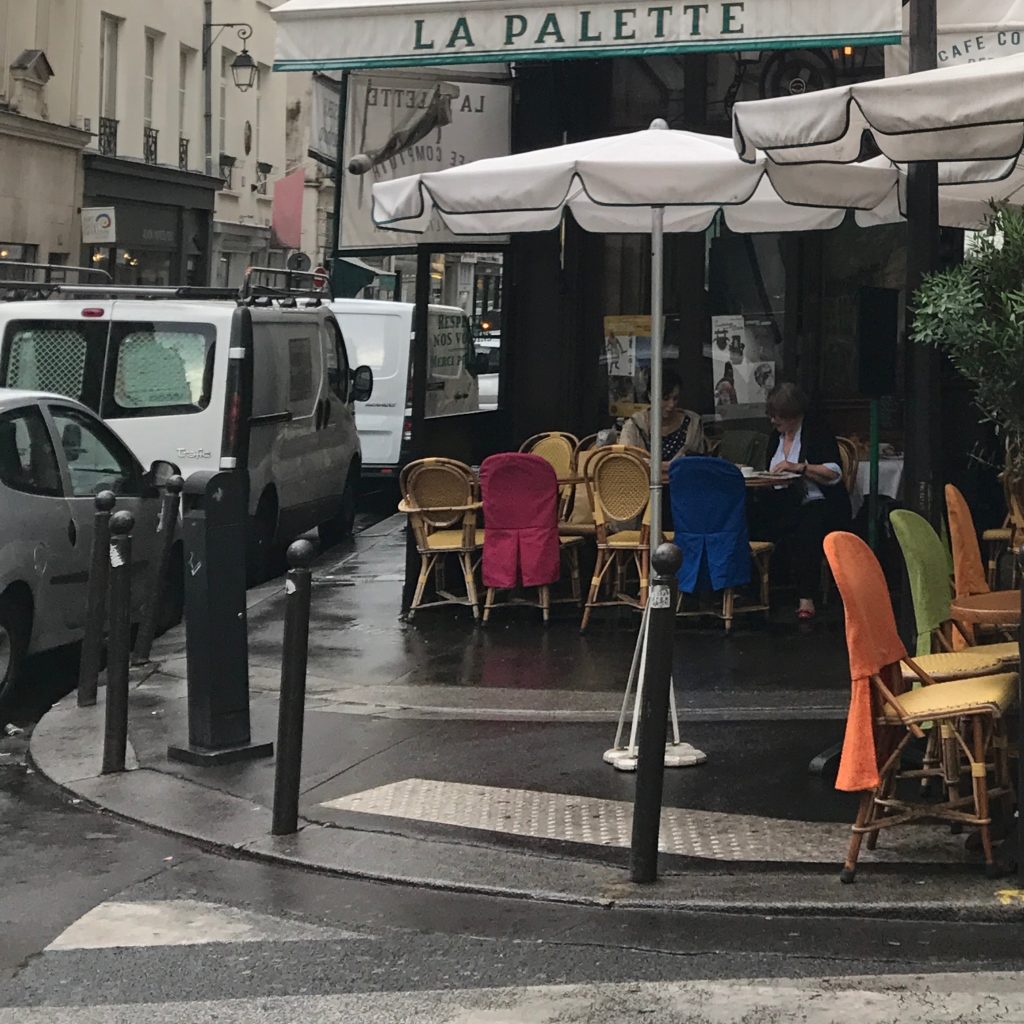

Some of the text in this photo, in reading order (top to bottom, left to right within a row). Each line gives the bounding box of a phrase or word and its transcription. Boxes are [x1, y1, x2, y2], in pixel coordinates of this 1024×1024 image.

[413, 2, 745, 50] LA PALETTE
[938, 35, 986, 63] CAFE
[433, 332, 452, 347] NOS
